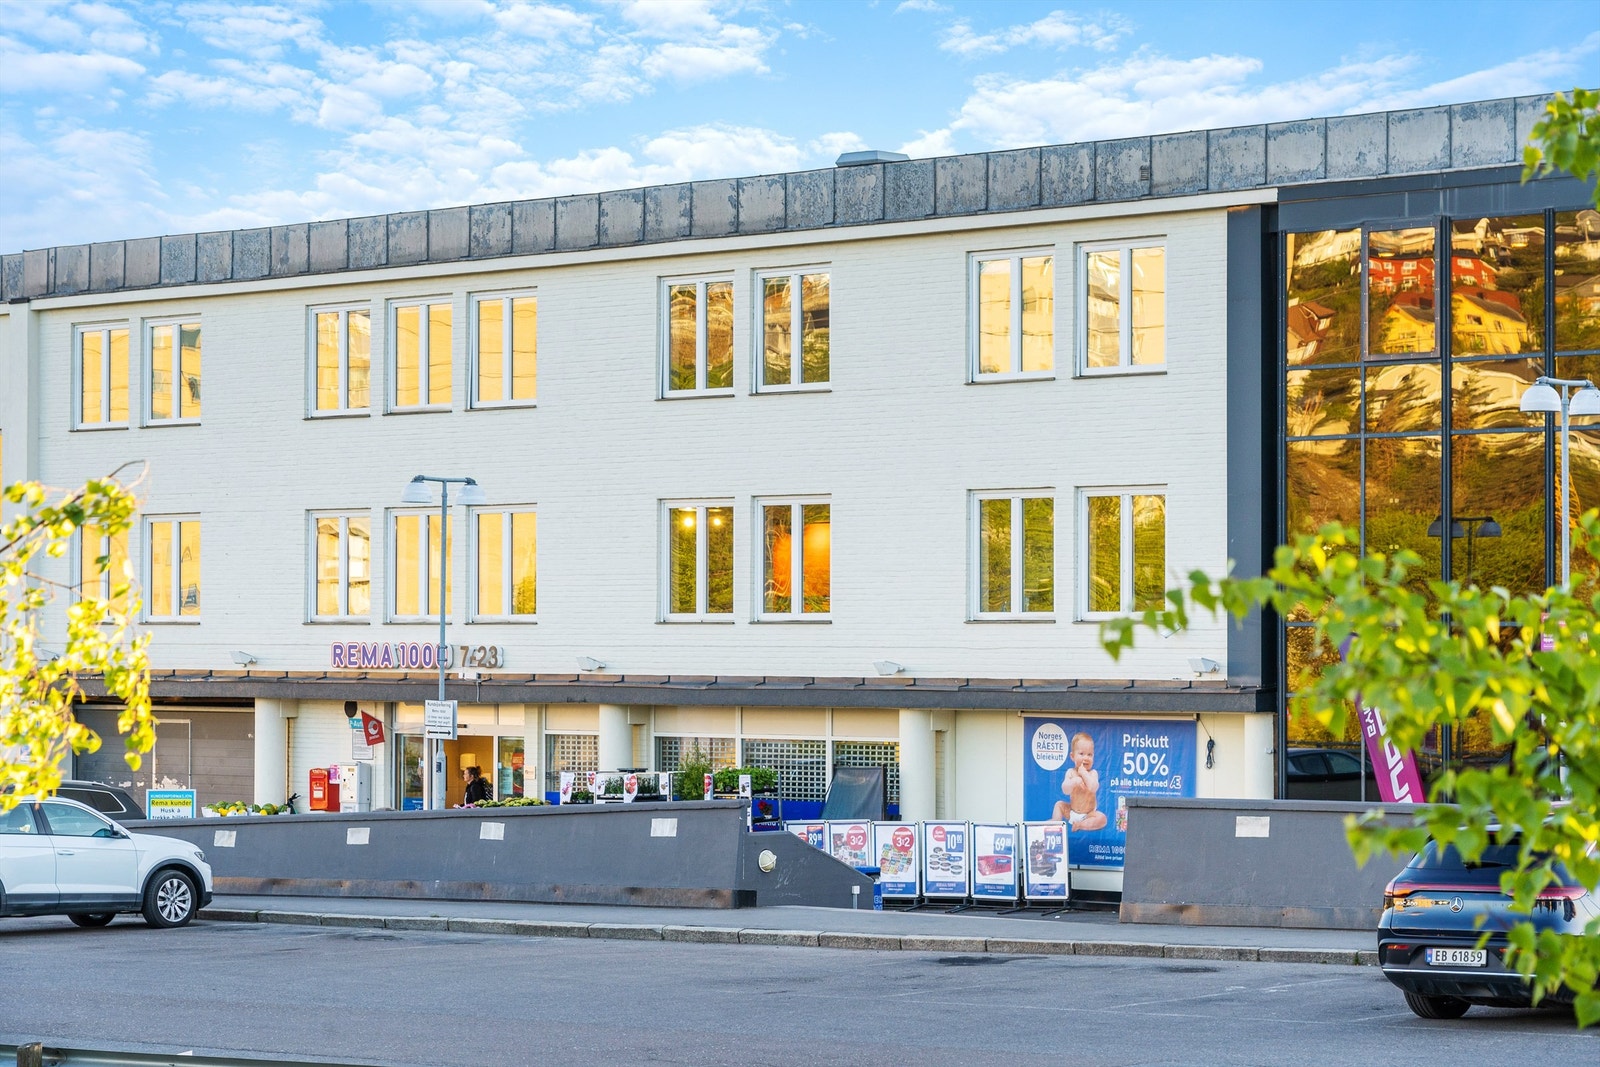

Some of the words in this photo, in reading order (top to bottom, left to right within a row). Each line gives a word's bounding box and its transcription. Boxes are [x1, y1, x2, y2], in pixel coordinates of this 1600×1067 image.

[331, 642, 394, 669] REMA
[1038, 732, 1063, 741] Norges
[1122, 733, 1169, 748] Priskutt
[1036, 740, 1064, 750] RÅESTE
[1036, 753, 1064, 761] bleiekutt
[1122, 752, 1169, 776] 50%
[1110, 777, 1119, 787] på
[1120, 778, 1132, 787] alle
[1133, 778, 1152, 787] bleier
[1153, 779, 1168, 788] med
[808, 833, 818, 846] 89
[946, 834, 957, 850] 10
[995, 837, 1006, 851] 69
[1045, 835, 1056, 850] 79
[1088, 844, 1111, 854] REMA
[1435, 950, 1448, 962] EB
[1451, 950, 1483, 963] 61859
